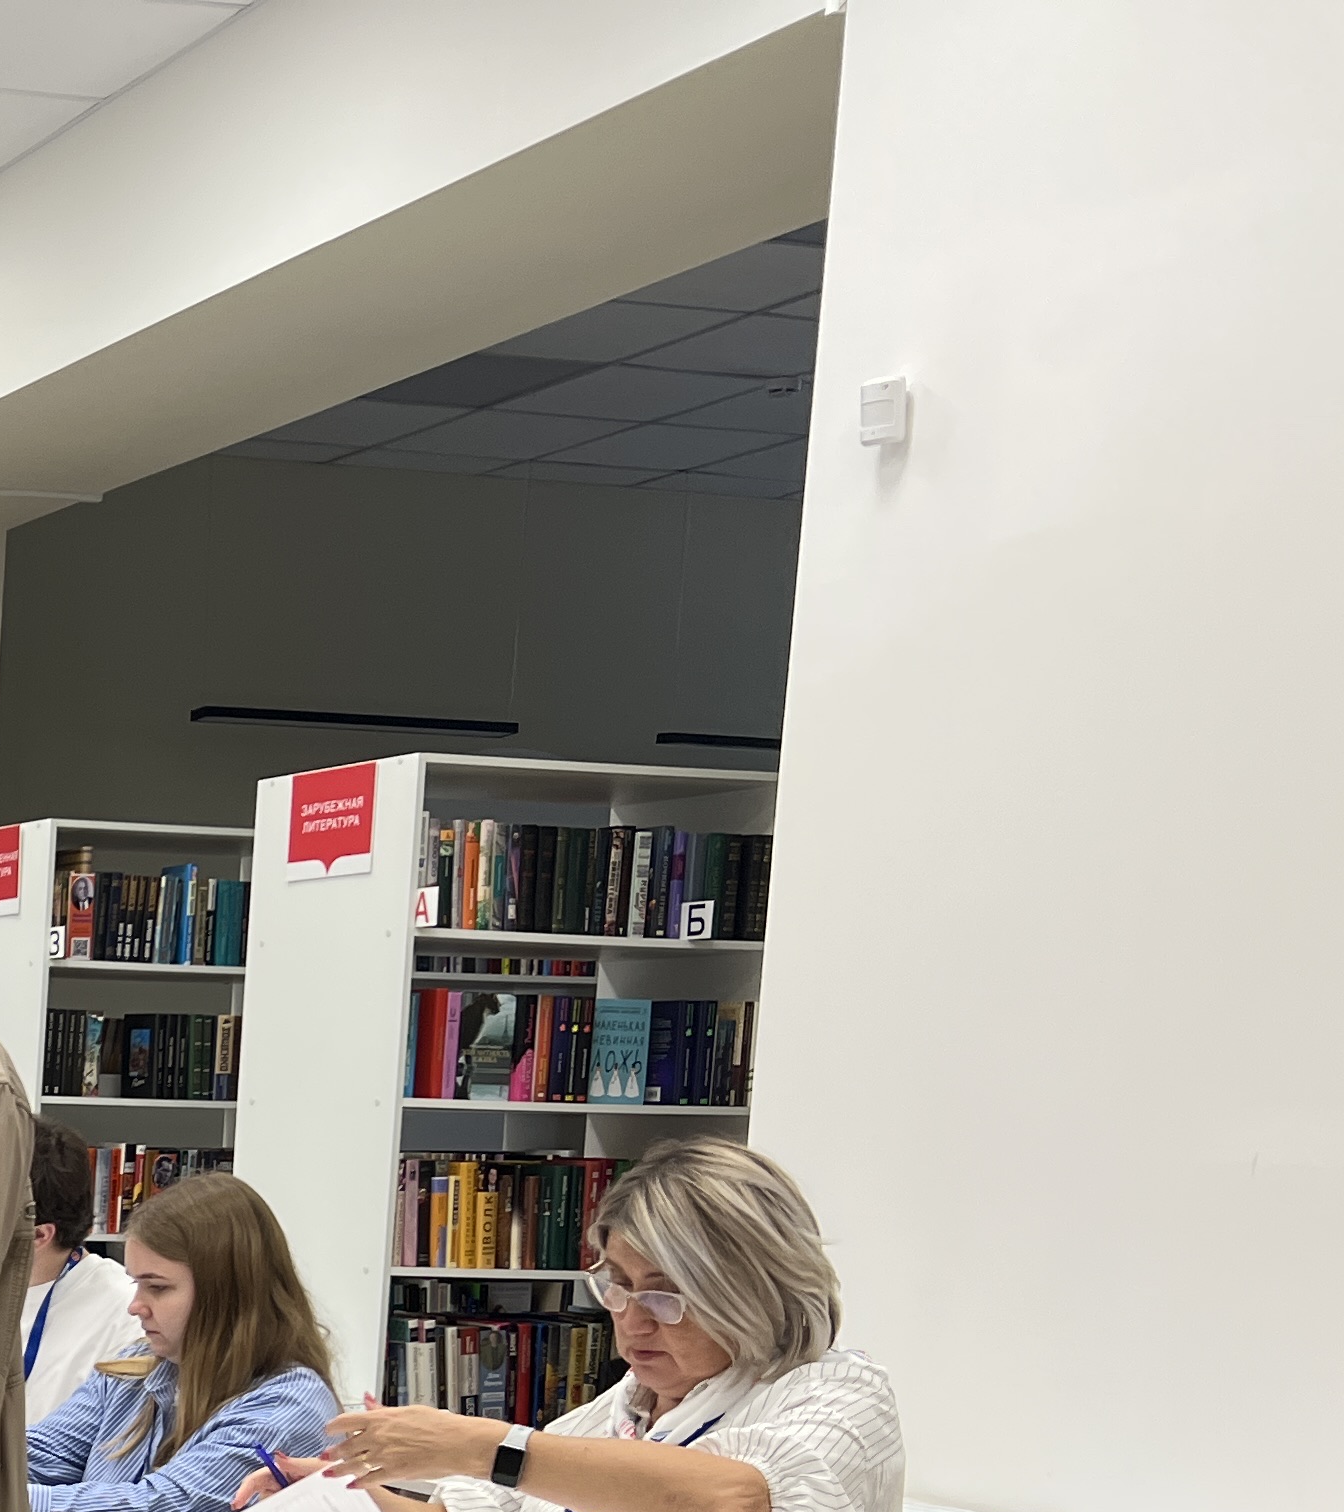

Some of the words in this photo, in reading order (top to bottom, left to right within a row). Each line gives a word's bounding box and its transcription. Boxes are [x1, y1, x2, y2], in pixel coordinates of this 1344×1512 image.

[300, 795, 364, 817] ЗАРУБЕЖНАЯ
[301, 814, 360, 835] ЛИТЕРАТУРА
[415, 891, 430, 924] А
[687, 903, 707, 937] Б
[594, 1019, 646, 1032] МАЛЕНЬКАЯ
[593, 1034, 645, 1047] НЕВИННАЯ
[591, 1049, 643, 1075] ЛОЖЬ
[482, 1194, 495, 1246] ВОЛК
